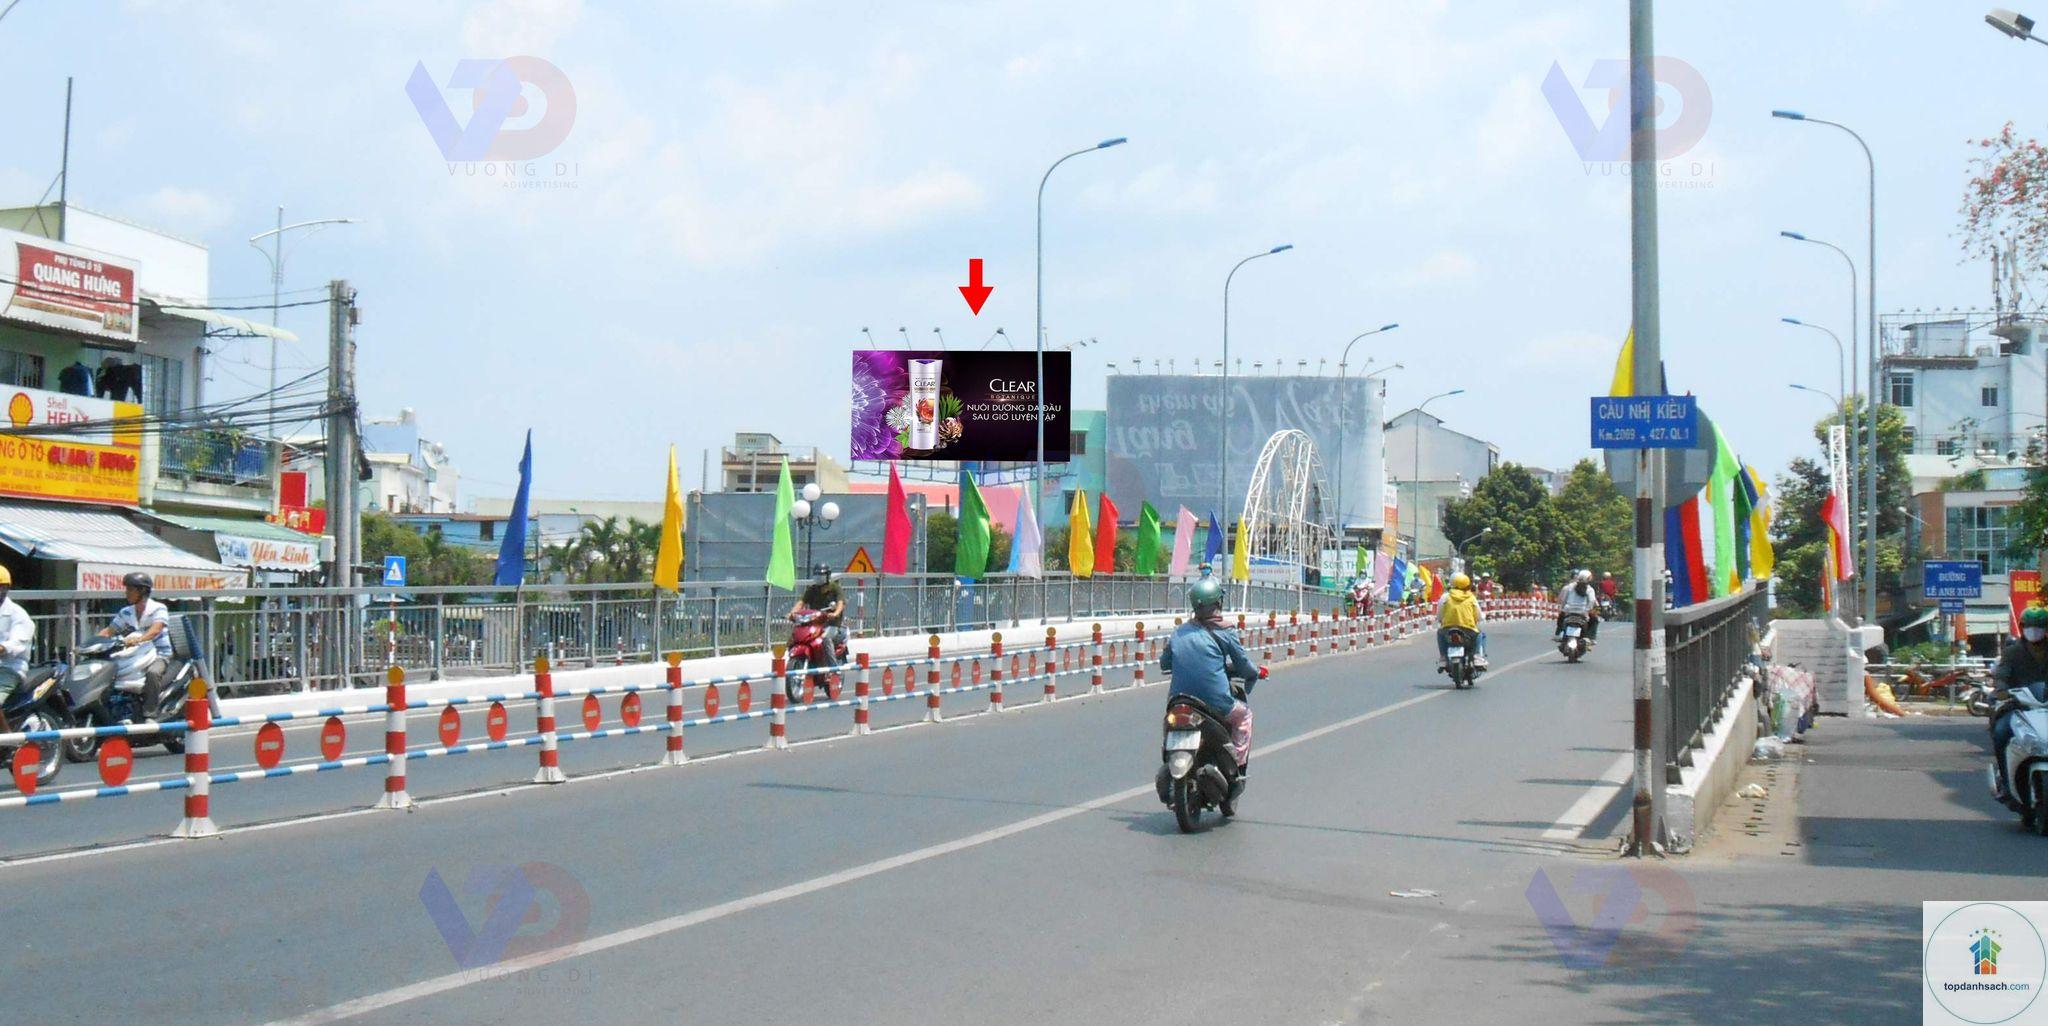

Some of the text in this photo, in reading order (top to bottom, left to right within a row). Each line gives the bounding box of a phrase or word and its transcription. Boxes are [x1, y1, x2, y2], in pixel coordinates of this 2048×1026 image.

[33, 262, 80, 288] QUANG
[989, 379, 1035, 393] CLEAR
[47, 397, 68, 409] Shell
[966, 404, 990, 412] NUÔI
[1599, 399, 1624, 420] CẦU
[972, 413, 990, 421] SAU
